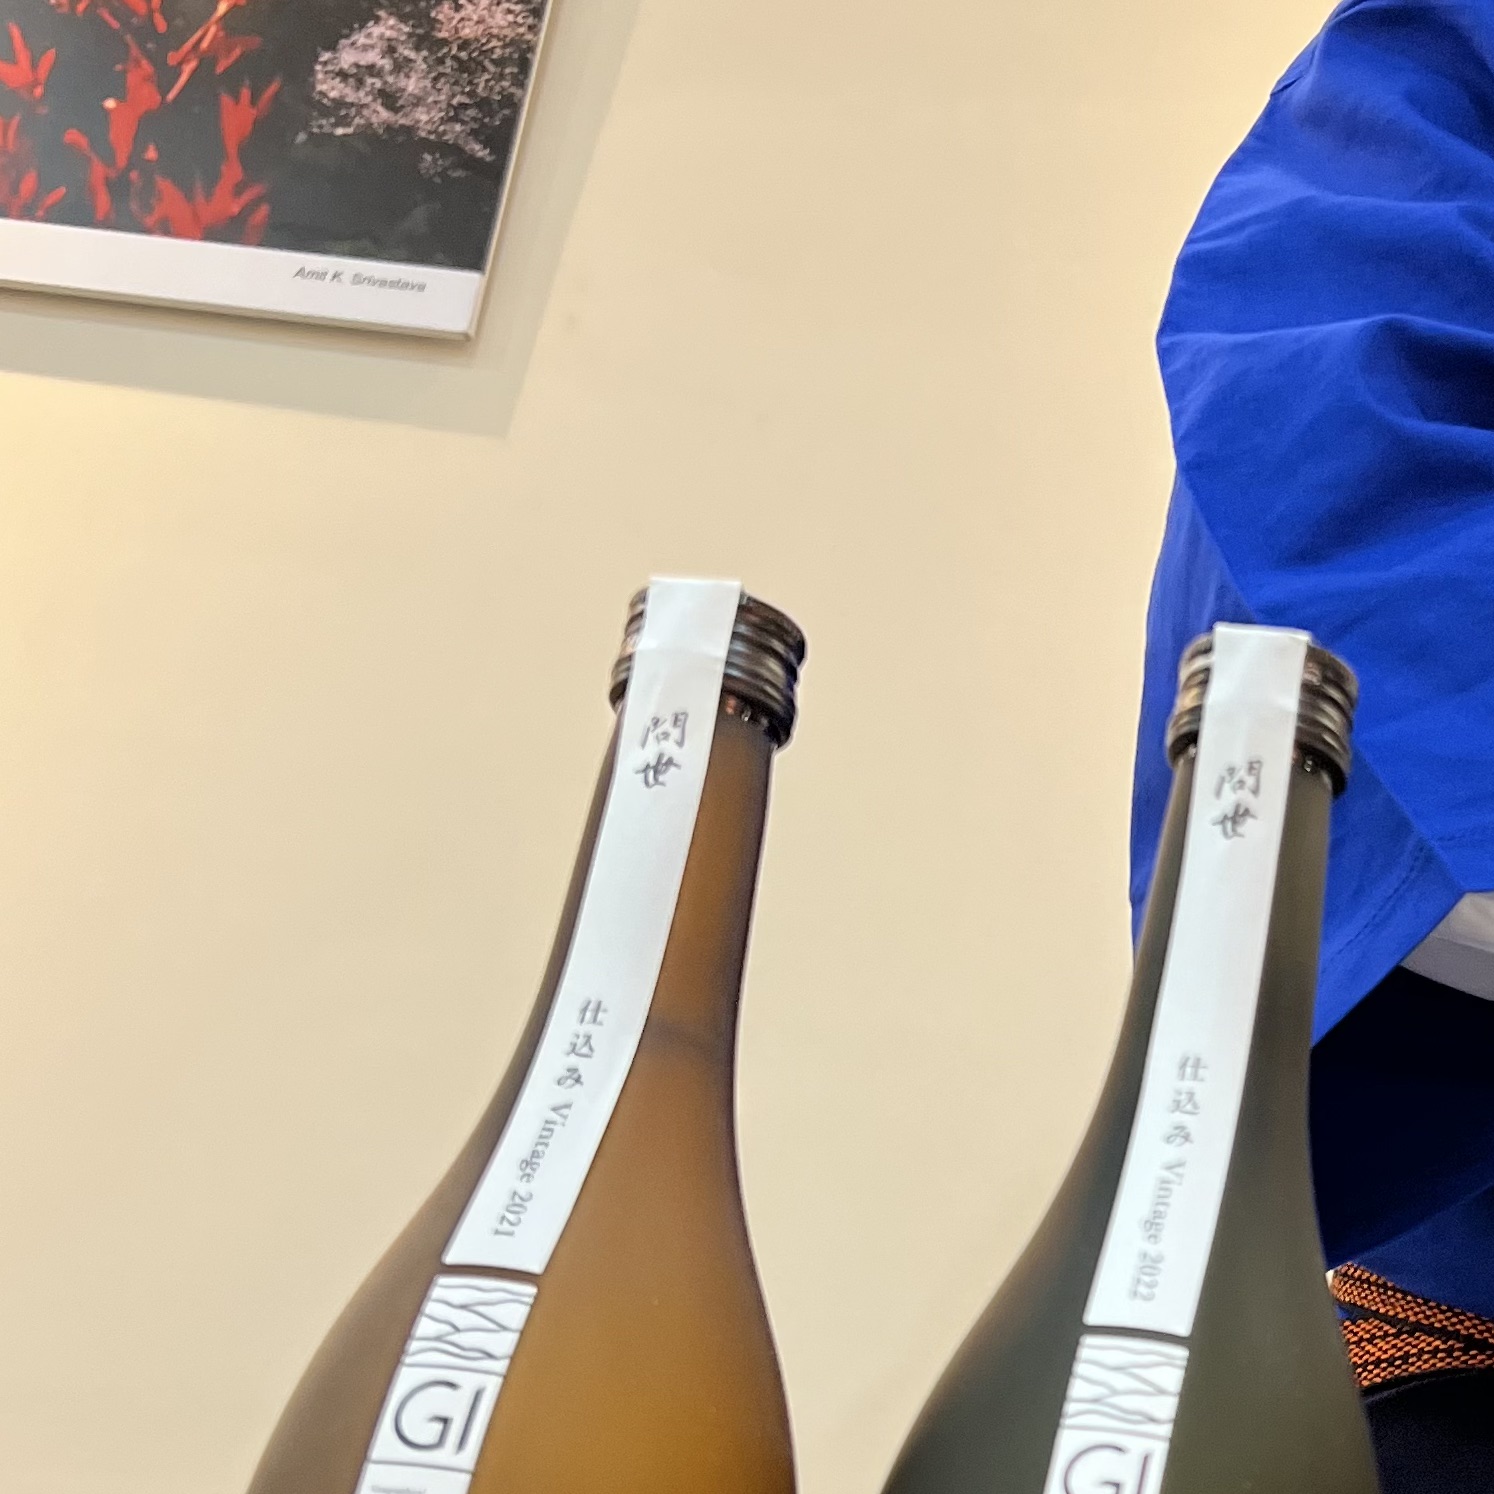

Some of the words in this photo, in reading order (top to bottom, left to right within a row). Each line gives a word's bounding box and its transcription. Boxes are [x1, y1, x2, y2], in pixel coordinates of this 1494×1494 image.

[557, 997, 608, 1089] 仕込み
[519, 1101, 573, 1184] Vintage
[1163, 1056, 1208, 1147] 仕込み
[494, 1190, 534, 1238] 2021
[1140, 1159, 1187, 1246] Vintage
[1128, 1249, 1165, 1302] 2022
[394, 1380, 486, 1455] GI
